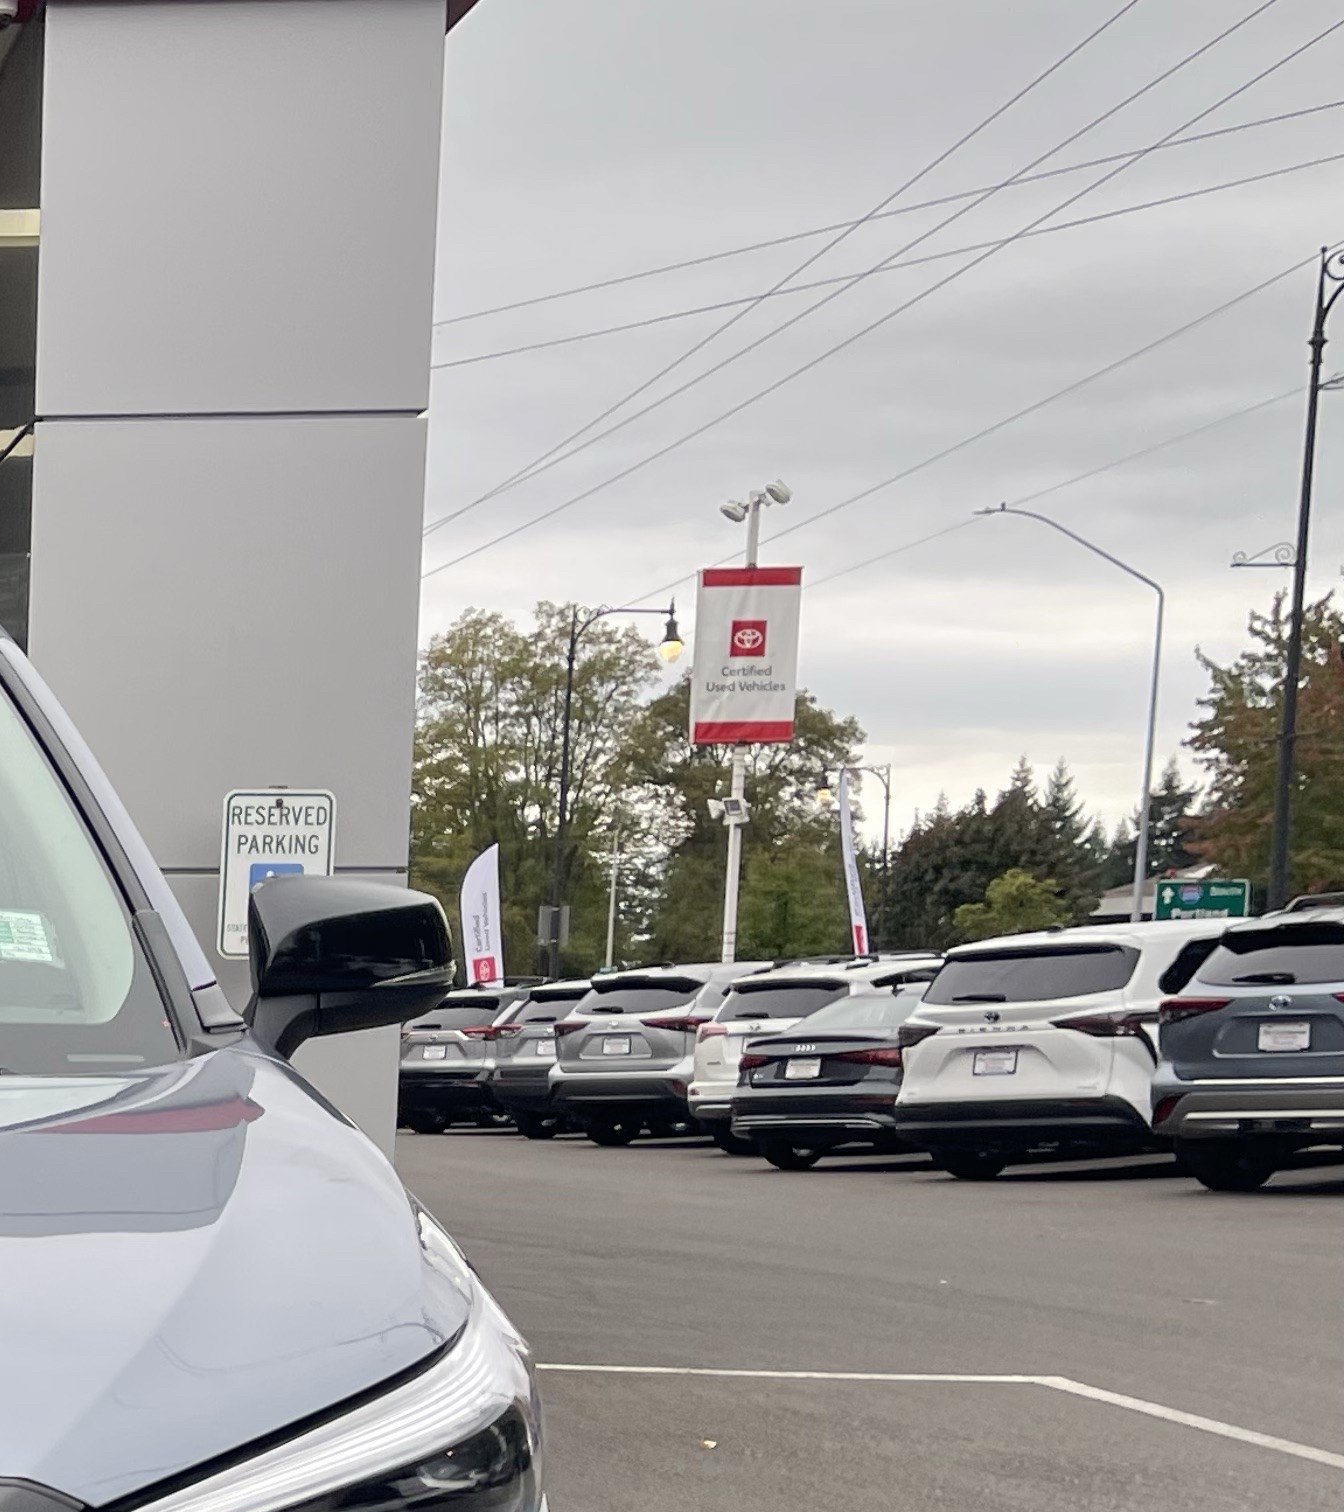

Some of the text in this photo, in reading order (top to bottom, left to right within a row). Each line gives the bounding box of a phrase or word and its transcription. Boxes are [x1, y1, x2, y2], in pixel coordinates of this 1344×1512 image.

[721, 665, 773, 677] Certified
[705, 680, 787, 692] Used Vehicles
[230, 805, 328, 826] RESERVED
[237, 834, 320, 855] PARKING
